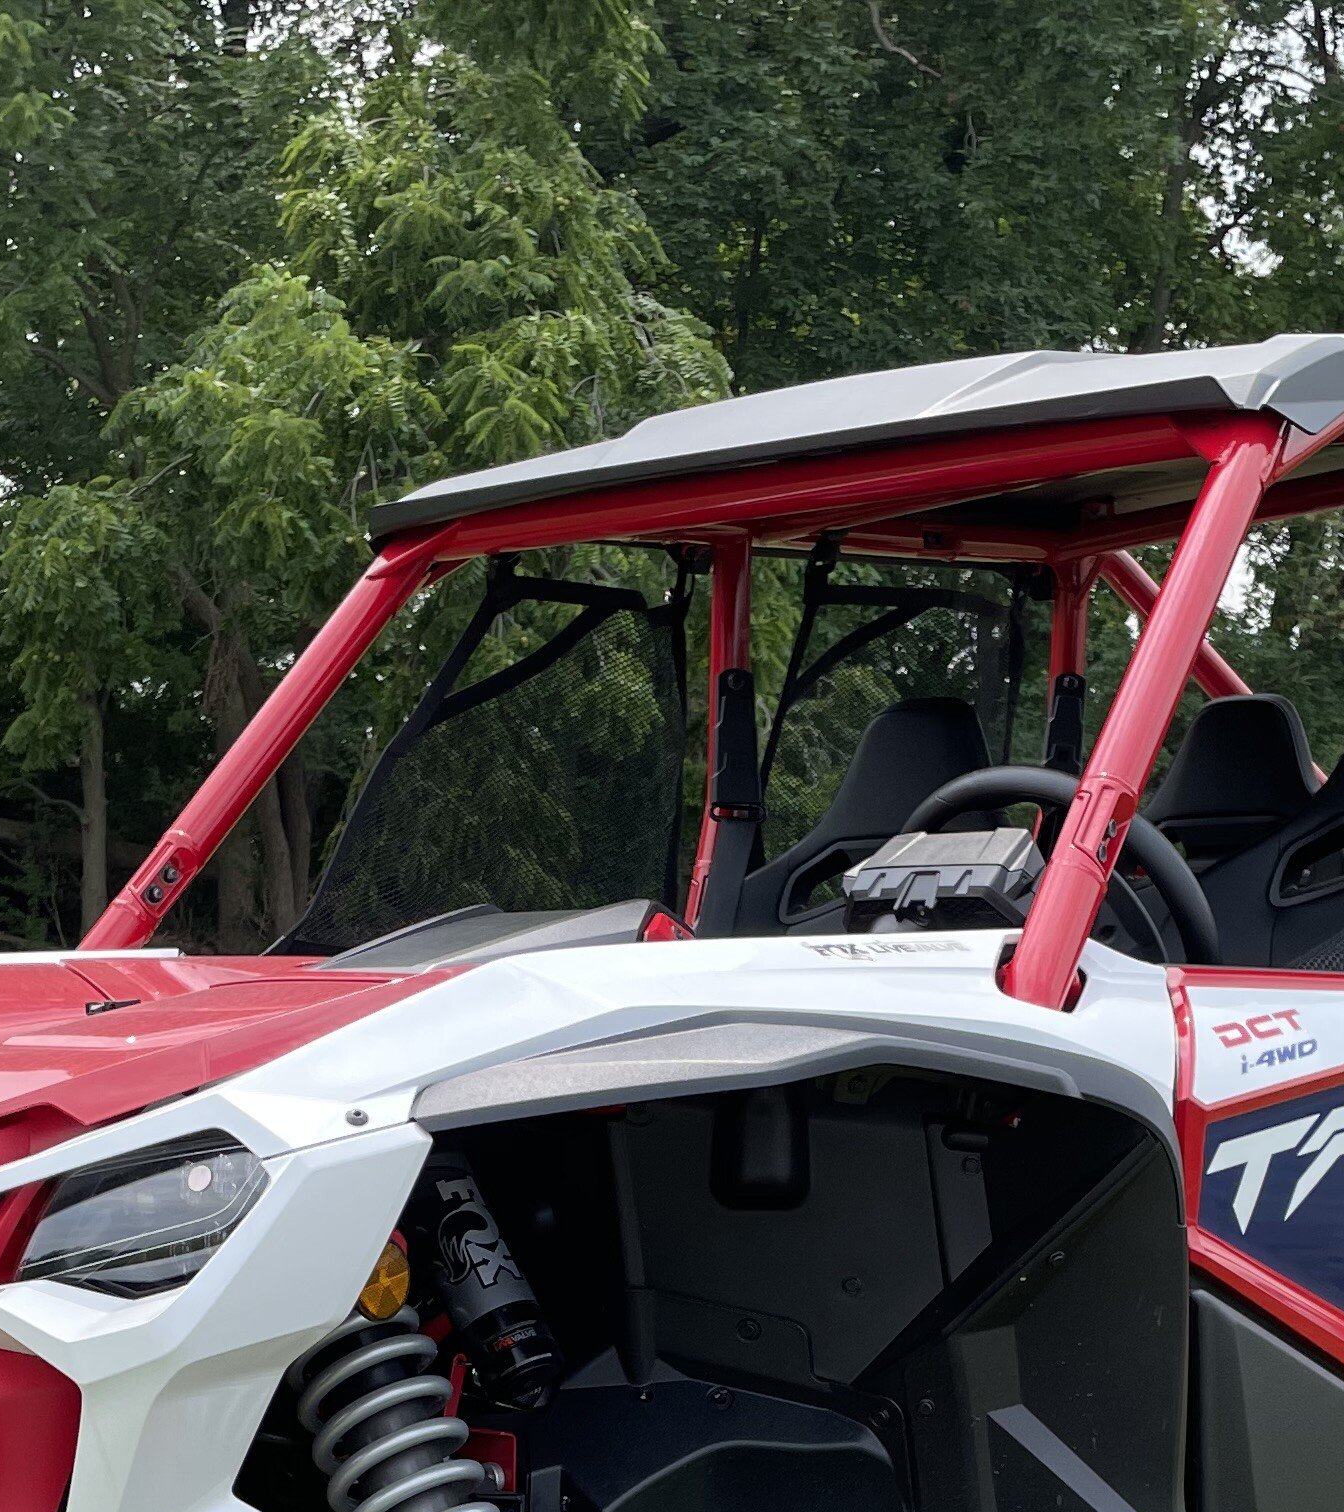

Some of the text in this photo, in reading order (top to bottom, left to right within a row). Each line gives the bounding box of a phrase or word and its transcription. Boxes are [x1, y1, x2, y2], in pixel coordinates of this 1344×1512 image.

[1212, 1008, 1302, 1049] DCT
[1241, 1038, 1318, 1075] i-4WD
[435, 1175, 524, 1289] FOX
